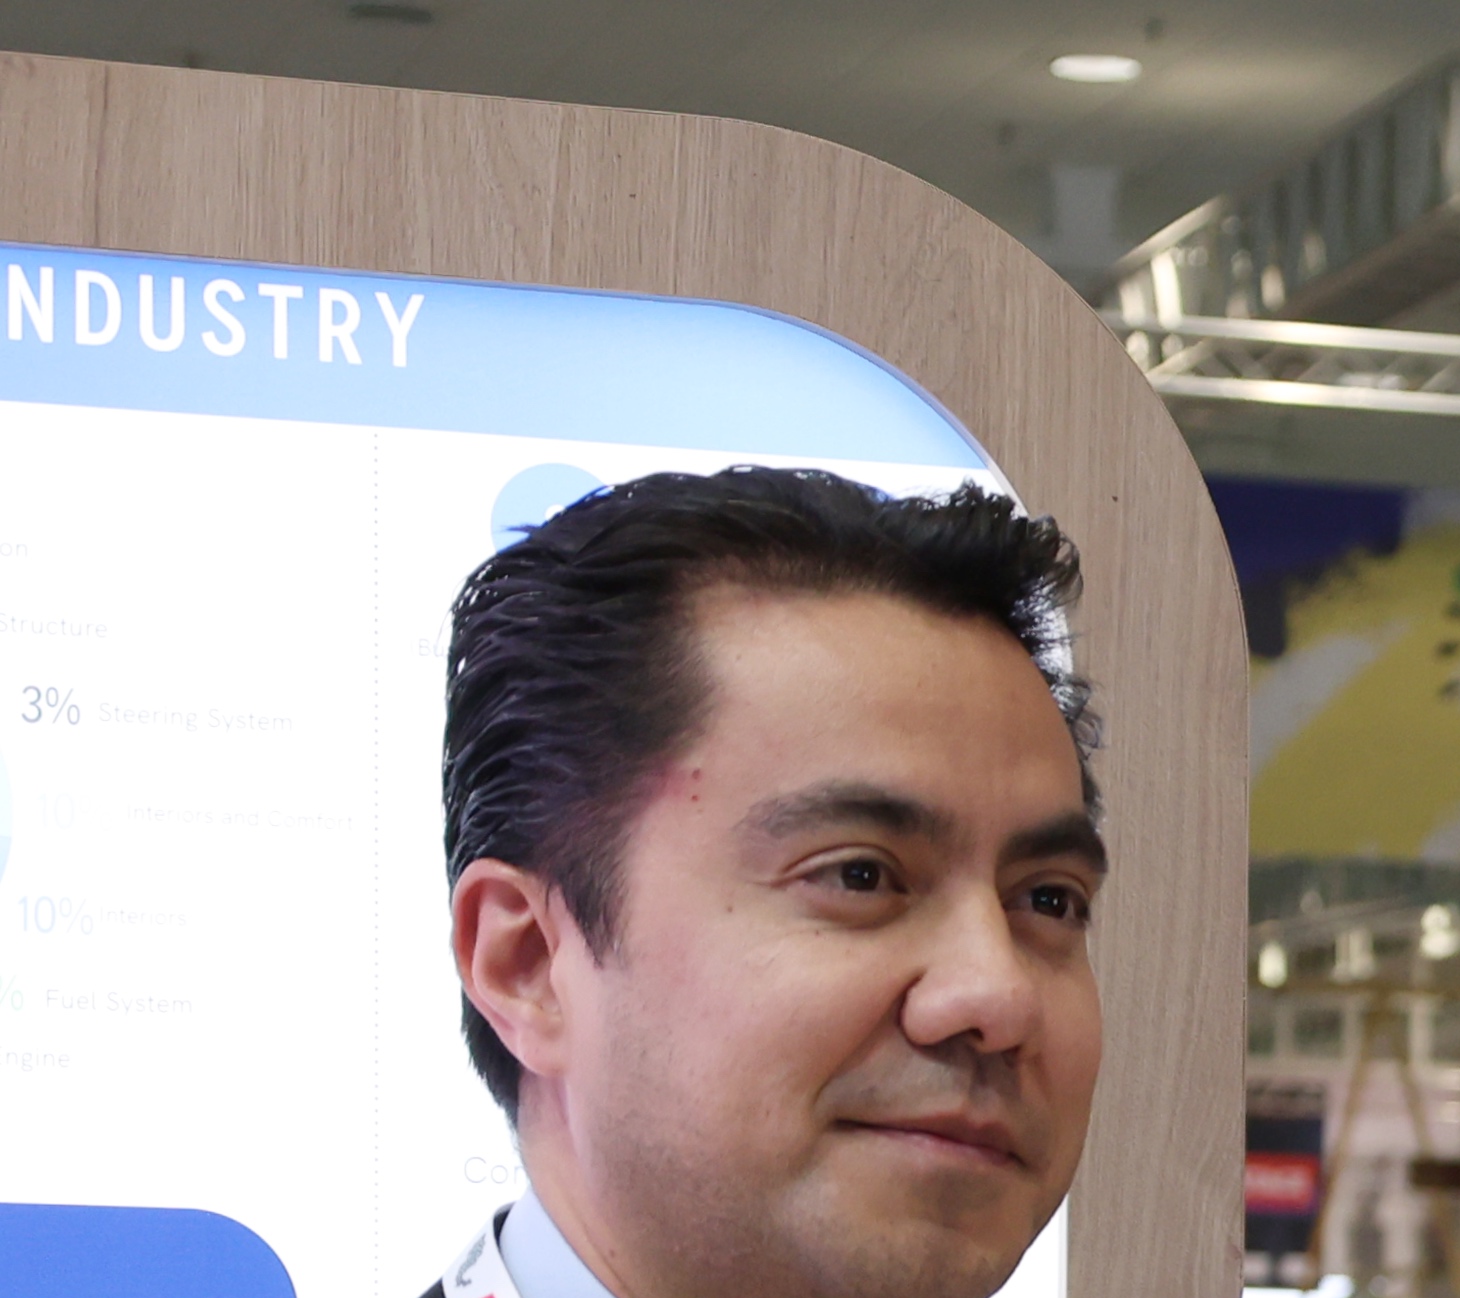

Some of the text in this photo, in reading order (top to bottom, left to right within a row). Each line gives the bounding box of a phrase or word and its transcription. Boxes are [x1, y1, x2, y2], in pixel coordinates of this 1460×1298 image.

[7, 264, 425, 367] NDUSTRY
[21, 685, 292, 732] 3% Steering System
[127, 804, 214, 824] Interiors
[222, 811, 260, 827] and
[267, 811, 353, 831] Comfort
[18, 896, 187, 935] 10% Interiors
[46, 989, 96, 1010] Fuel
[106, 992, 192, 1015] System
[0, 1047, 71, 1072] ngine
